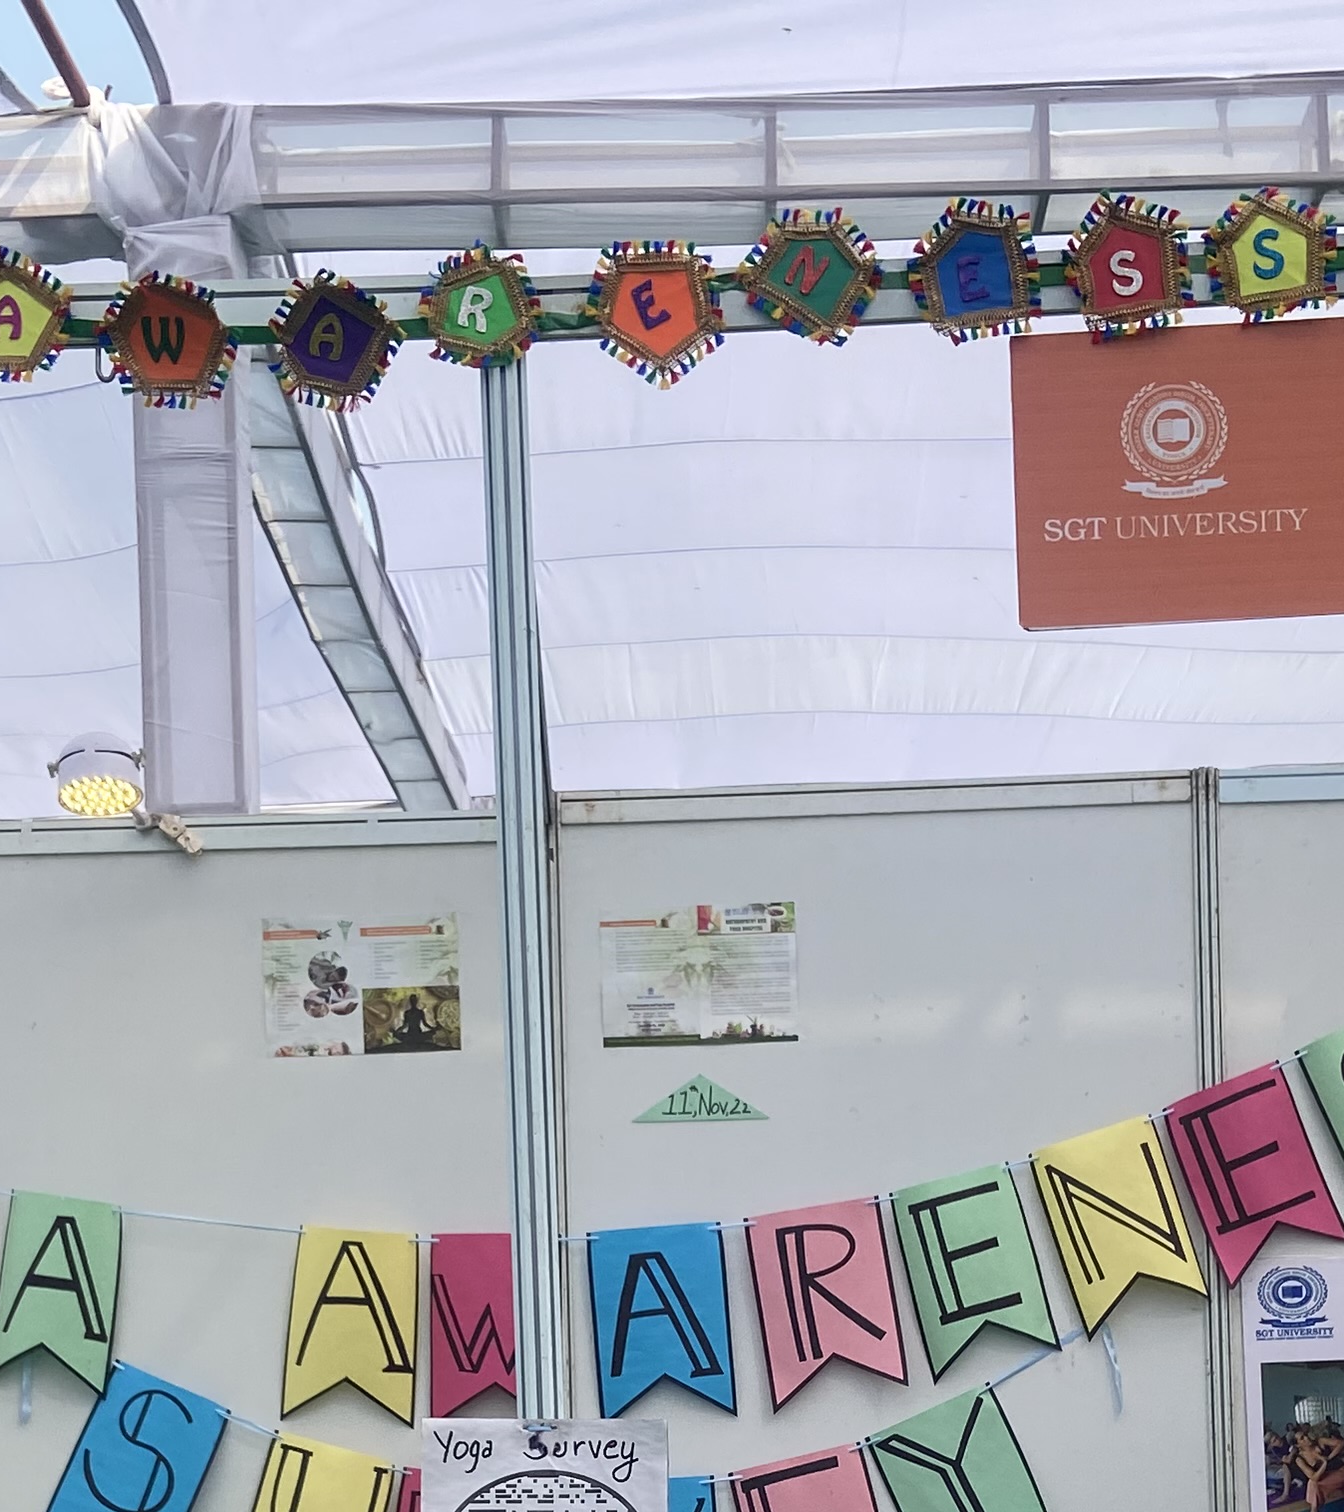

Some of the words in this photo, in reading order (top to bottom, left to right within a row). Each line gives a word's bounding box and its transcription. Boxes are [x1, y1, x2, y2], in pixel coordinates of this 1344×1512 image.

[1044, 517, 1107, 542] SGT
[1115, 508, 1308, 539] UNIVERSITY
[1277, 1326, 1334, 1337] UNIVERSITY
[433, 1430, 494, 1473] Yoga
[524, 1430, 639, 1482] Survey
